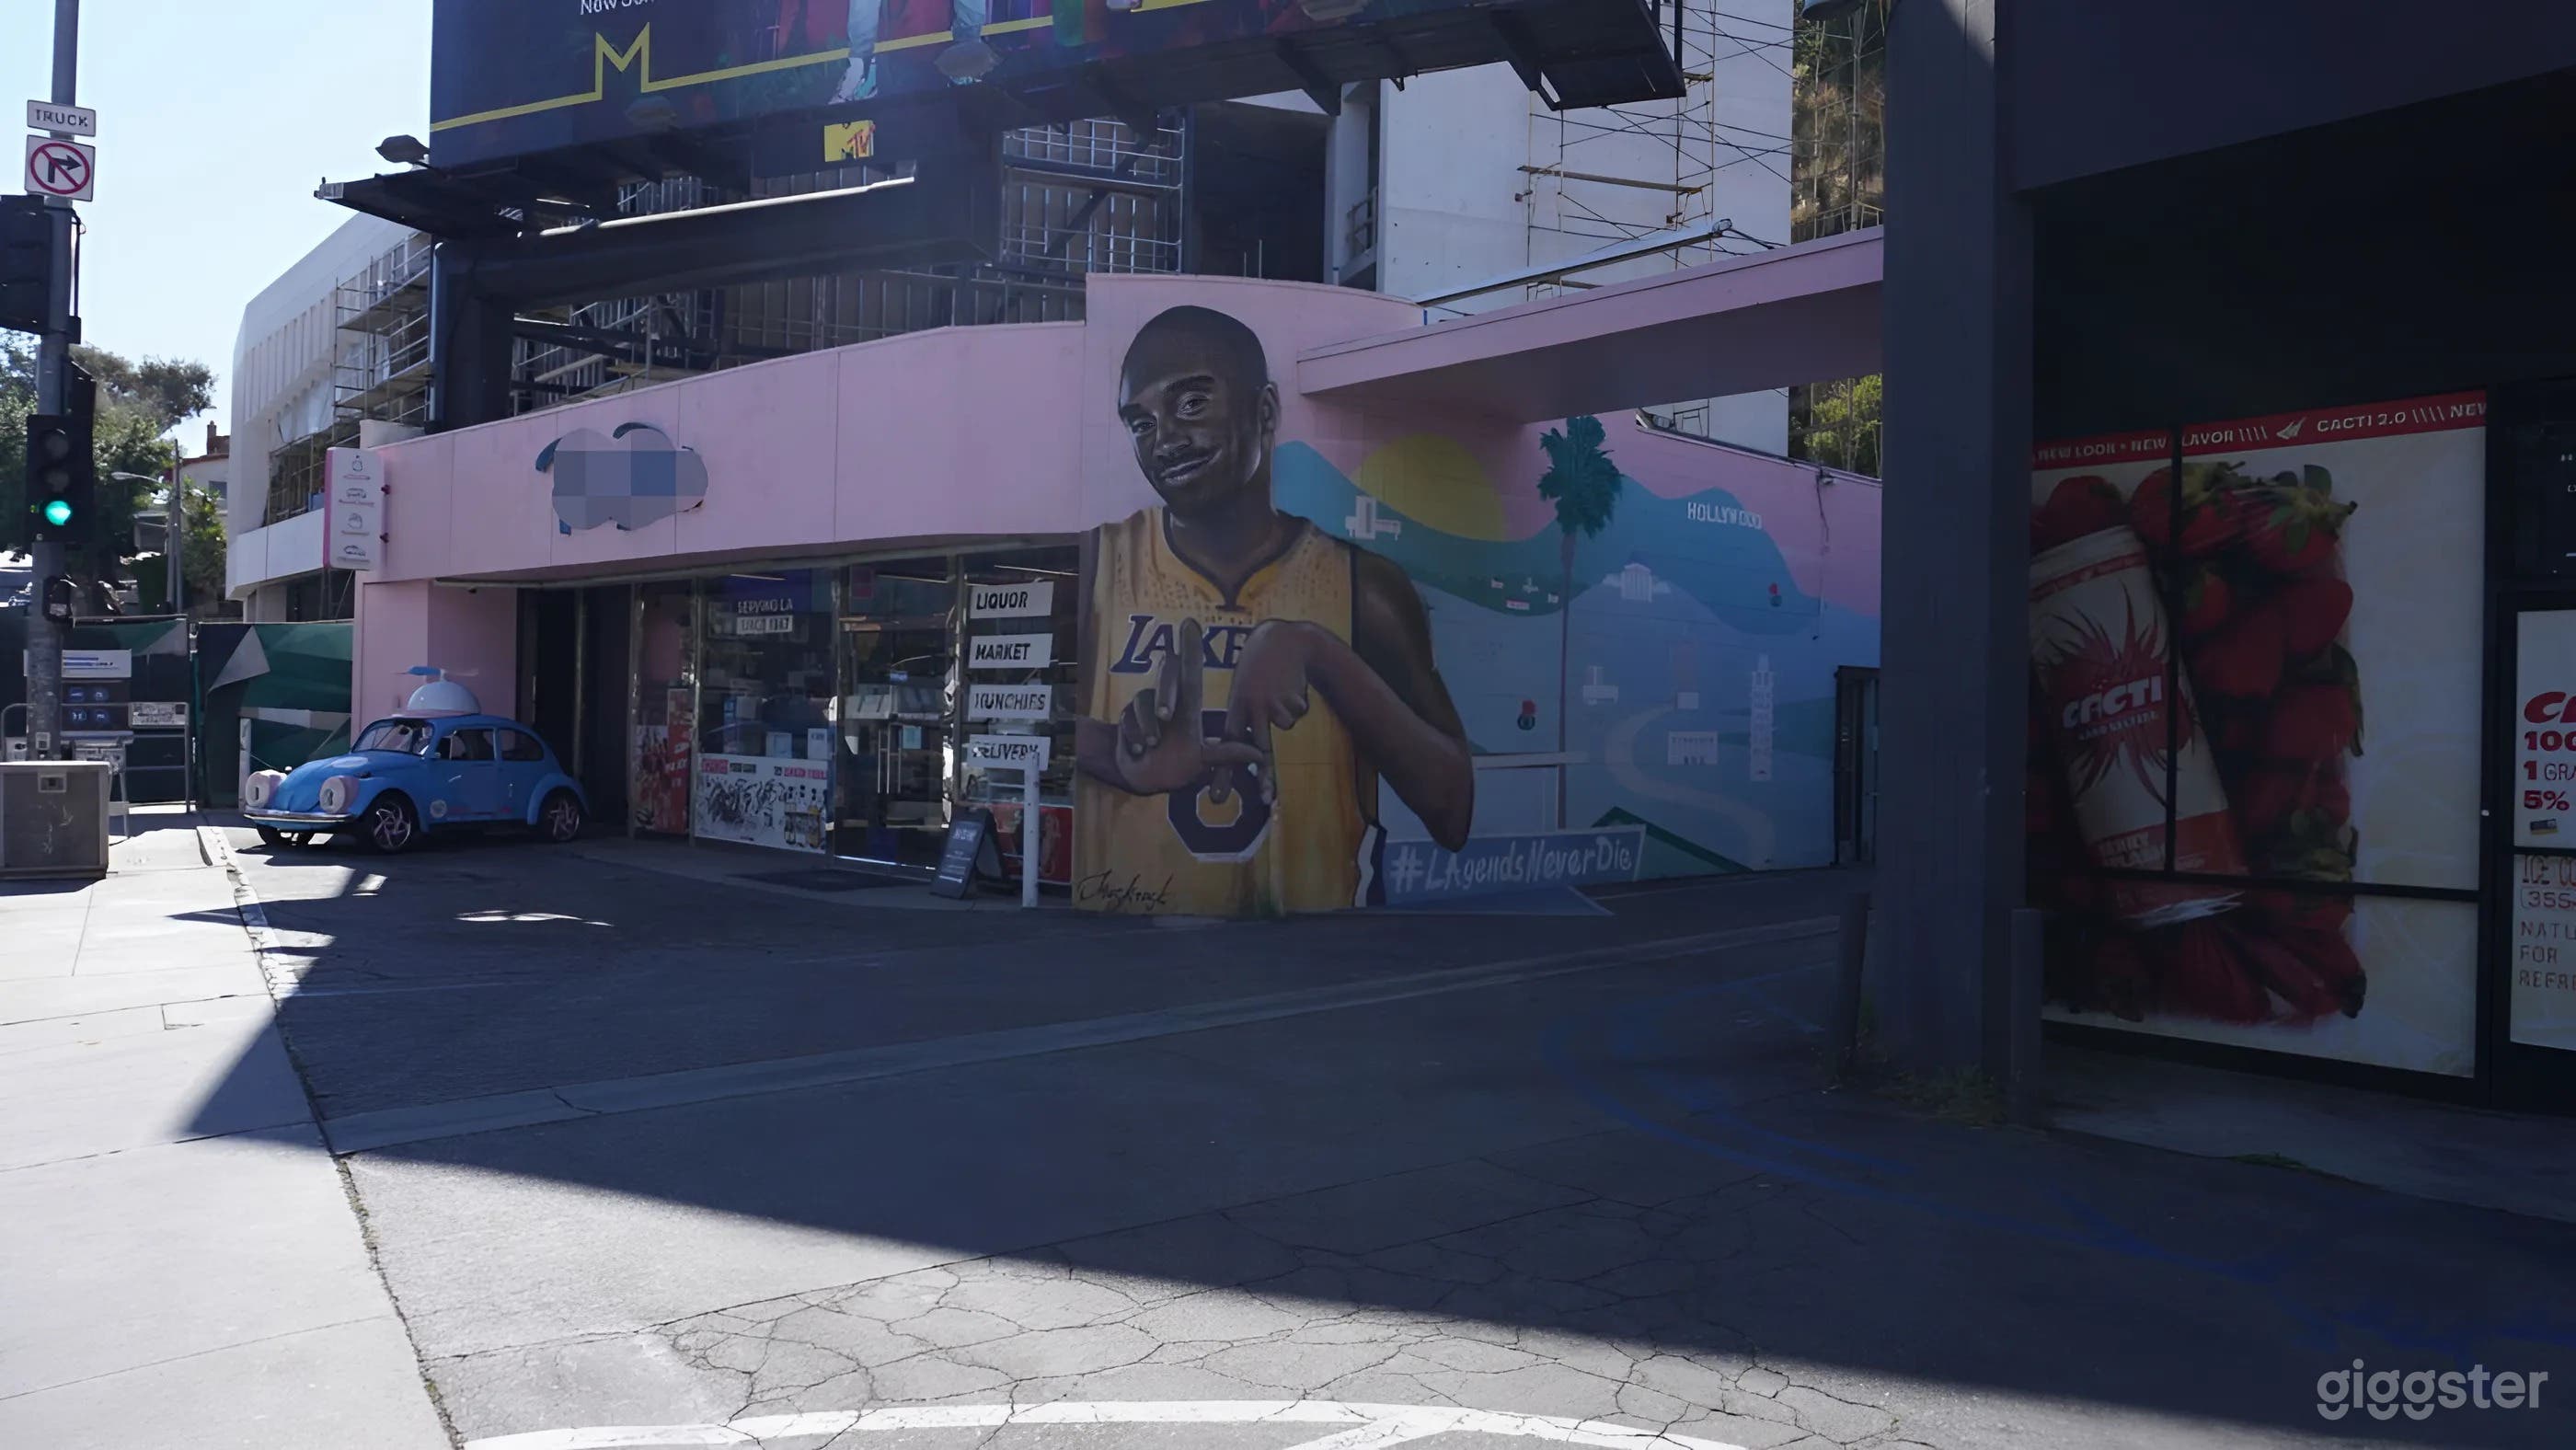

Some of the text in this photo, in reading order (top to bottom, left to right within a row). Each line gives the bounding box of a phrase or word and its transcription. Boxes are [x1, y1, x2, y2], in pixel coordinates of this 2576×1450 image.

[36, 109, 88, 127] TRUCK
[2132, 437, 2167, 452] NEW
[2181, 430, 2234, 446] LAVOR
[2317, 414, 2373, 432] CACTI
[2376, 411, 2407, 426] 2.0
[1687, 501, 1763, 530] HOLLYWOOD
[976, 592, 1029, 609] LIQUOR
[975, 643, 1031, 661] MARKET
[974, 692, 1046, 710] MUNCHIES
[2063, 674, 2163, 730] CACTI
[972, 742, 1039, 762] DELIVERY
[2524, 761, 2537, 780] 1
[2524, 789, 2570, 811] 5%
[2521, 945, 2558, 964] FOR
